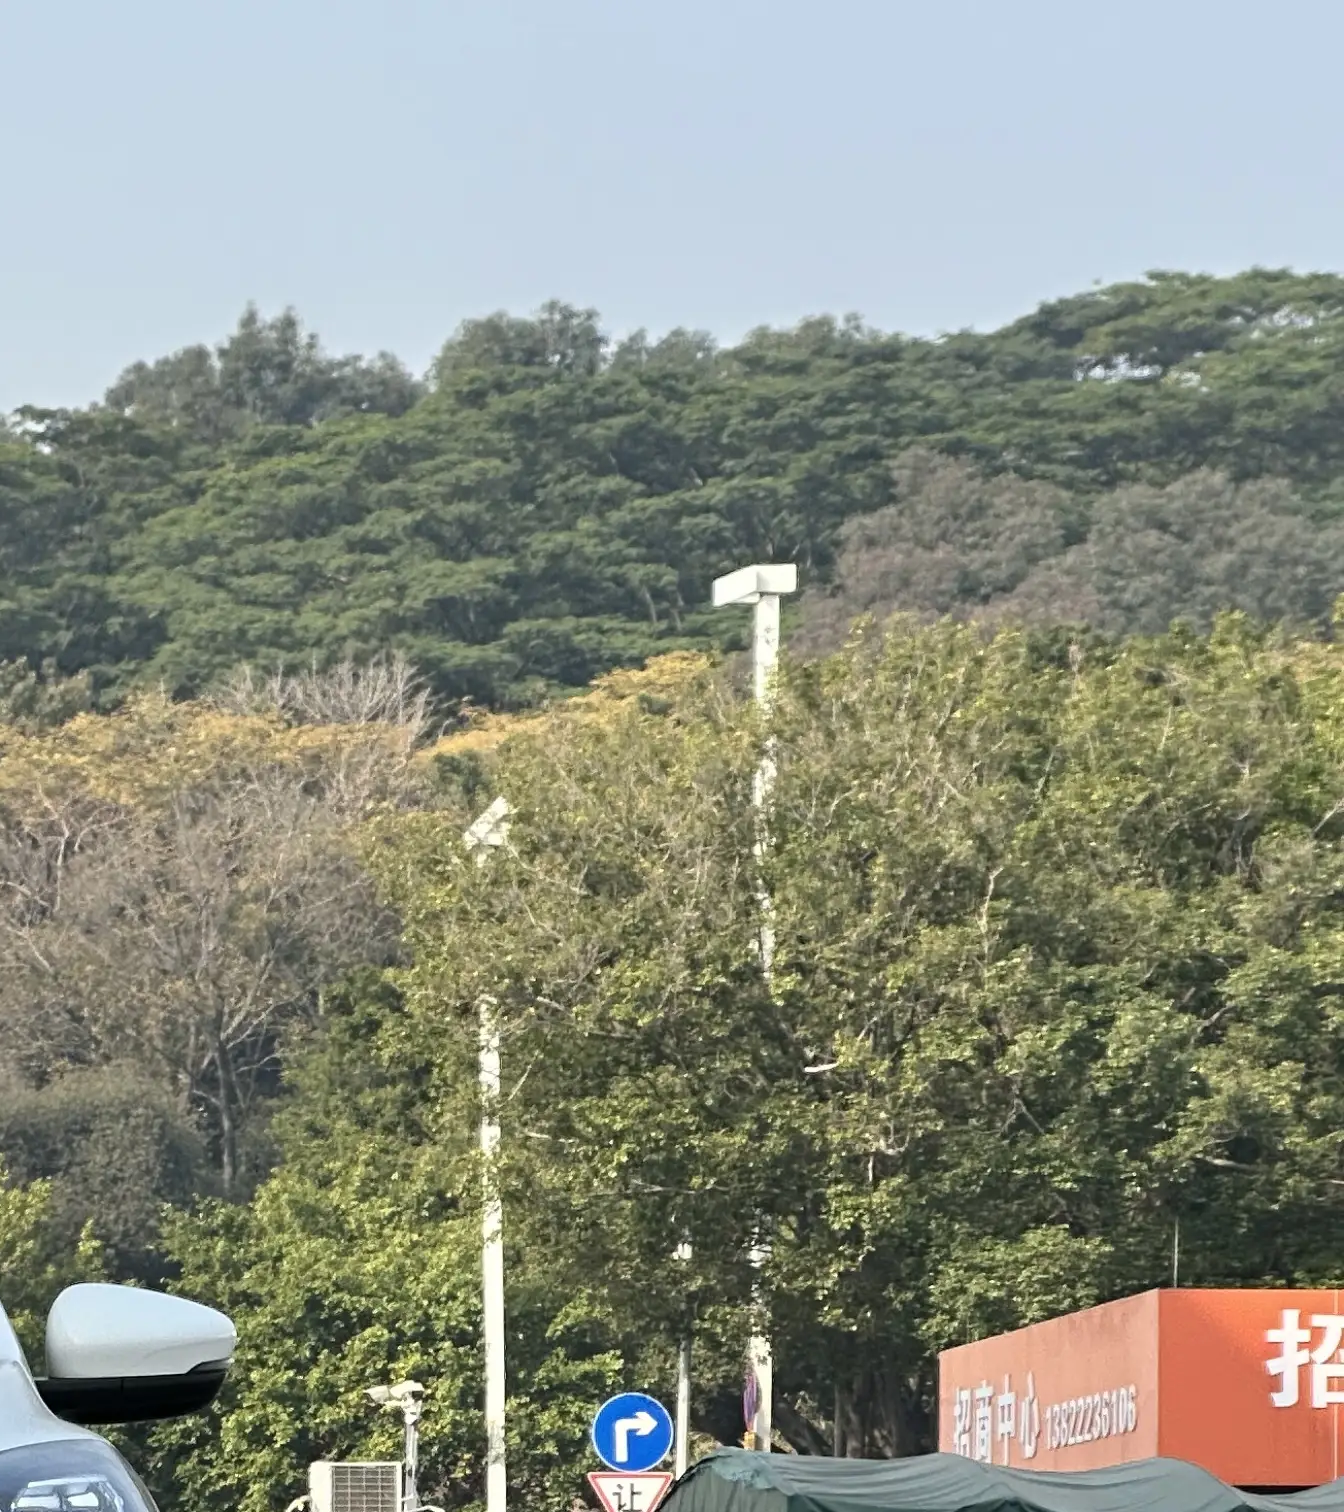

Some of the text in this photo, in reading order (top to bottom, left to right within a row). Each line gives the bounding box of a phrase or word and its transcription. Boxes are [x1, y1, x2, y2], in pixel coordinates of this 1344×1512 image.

[1266, 1309, 1344, 1408] 招
[954, 1370, 1040, 1466] 招商中心
[612, 1483, 643, 1512] 让
